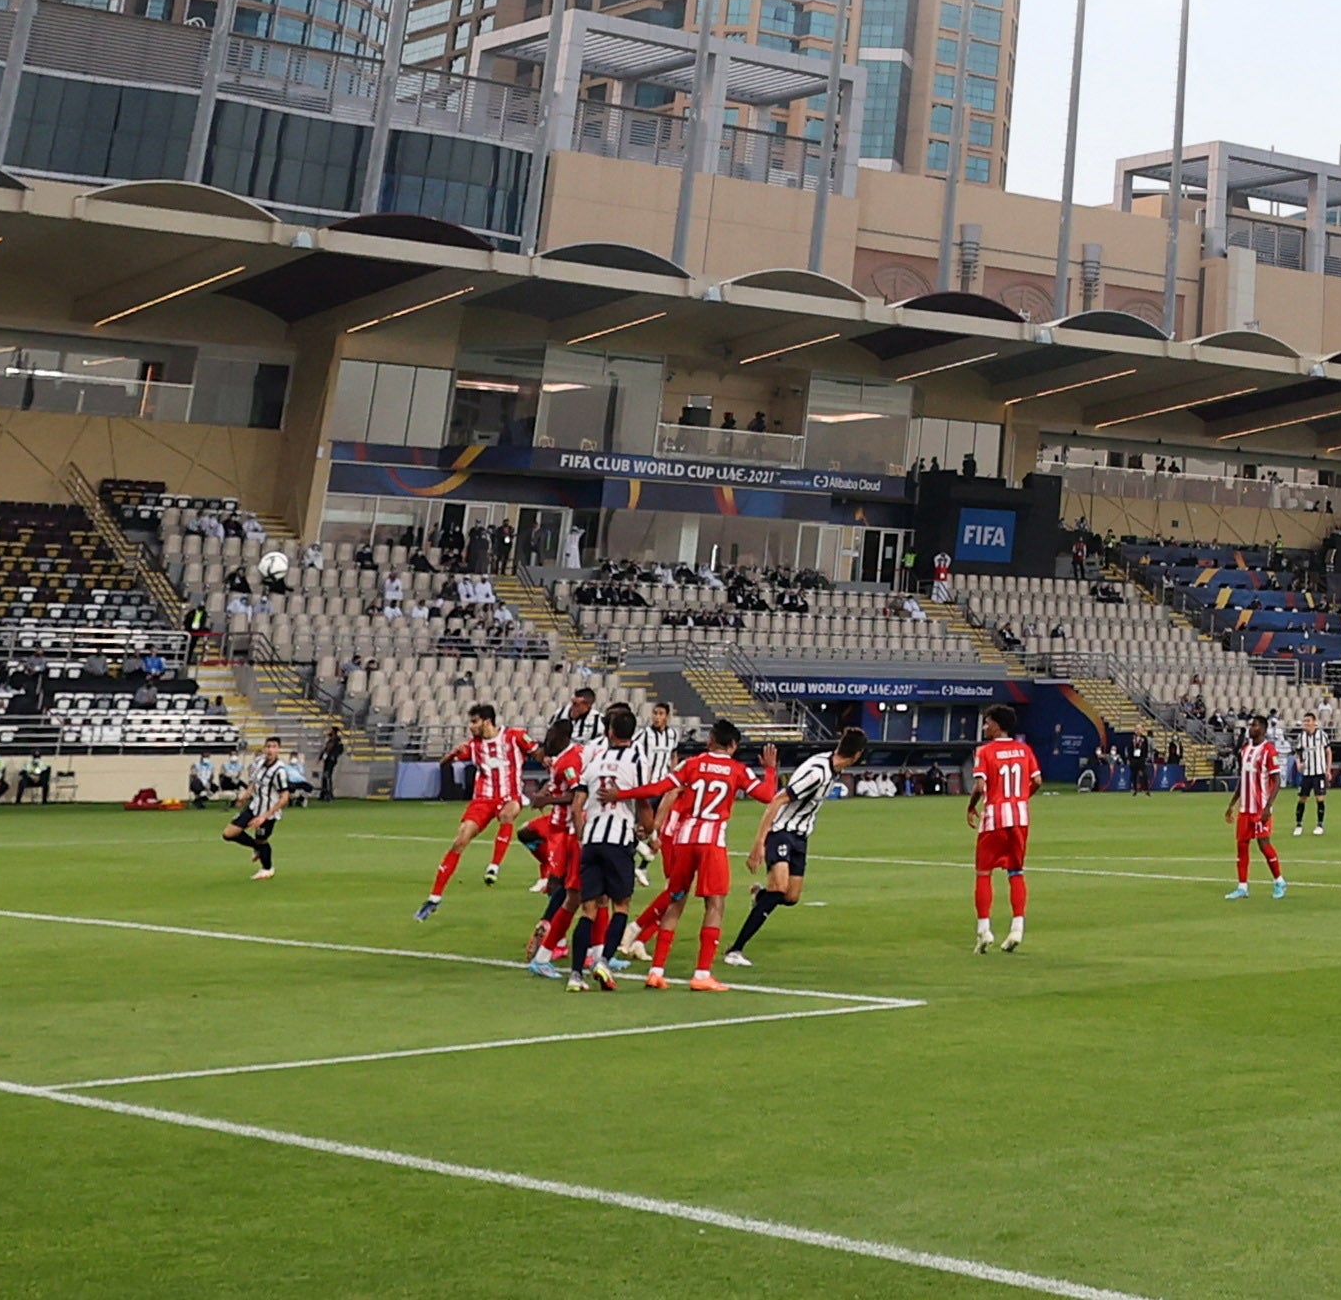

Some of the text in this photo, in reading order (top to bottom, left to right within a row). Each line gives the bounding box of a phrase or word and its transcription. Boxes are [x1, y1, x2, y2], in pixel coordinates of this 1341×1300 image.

[560, 454, 591, 469] FIFA
[593, 456, 630, 472] CLUB
[633, 460, 685, 477] WORLD
[687, 465, 715, 479] CUP
[716, 467, 748, 482] UAE
[748, 470, 775, 484] 2021
[829, 476, 881, 491] Alibaba Cloud
[963, 524, 1006, 547] FIFA
[756, 683, 777, 693] FIFA
[778, 682, 806, 694] CLUB
[807, 683, 846, 694] WORLD
[847, 684, 868, 695] CUP
[999, 762, 1021, 799] 11
[691, 778, 729, 820] 12
